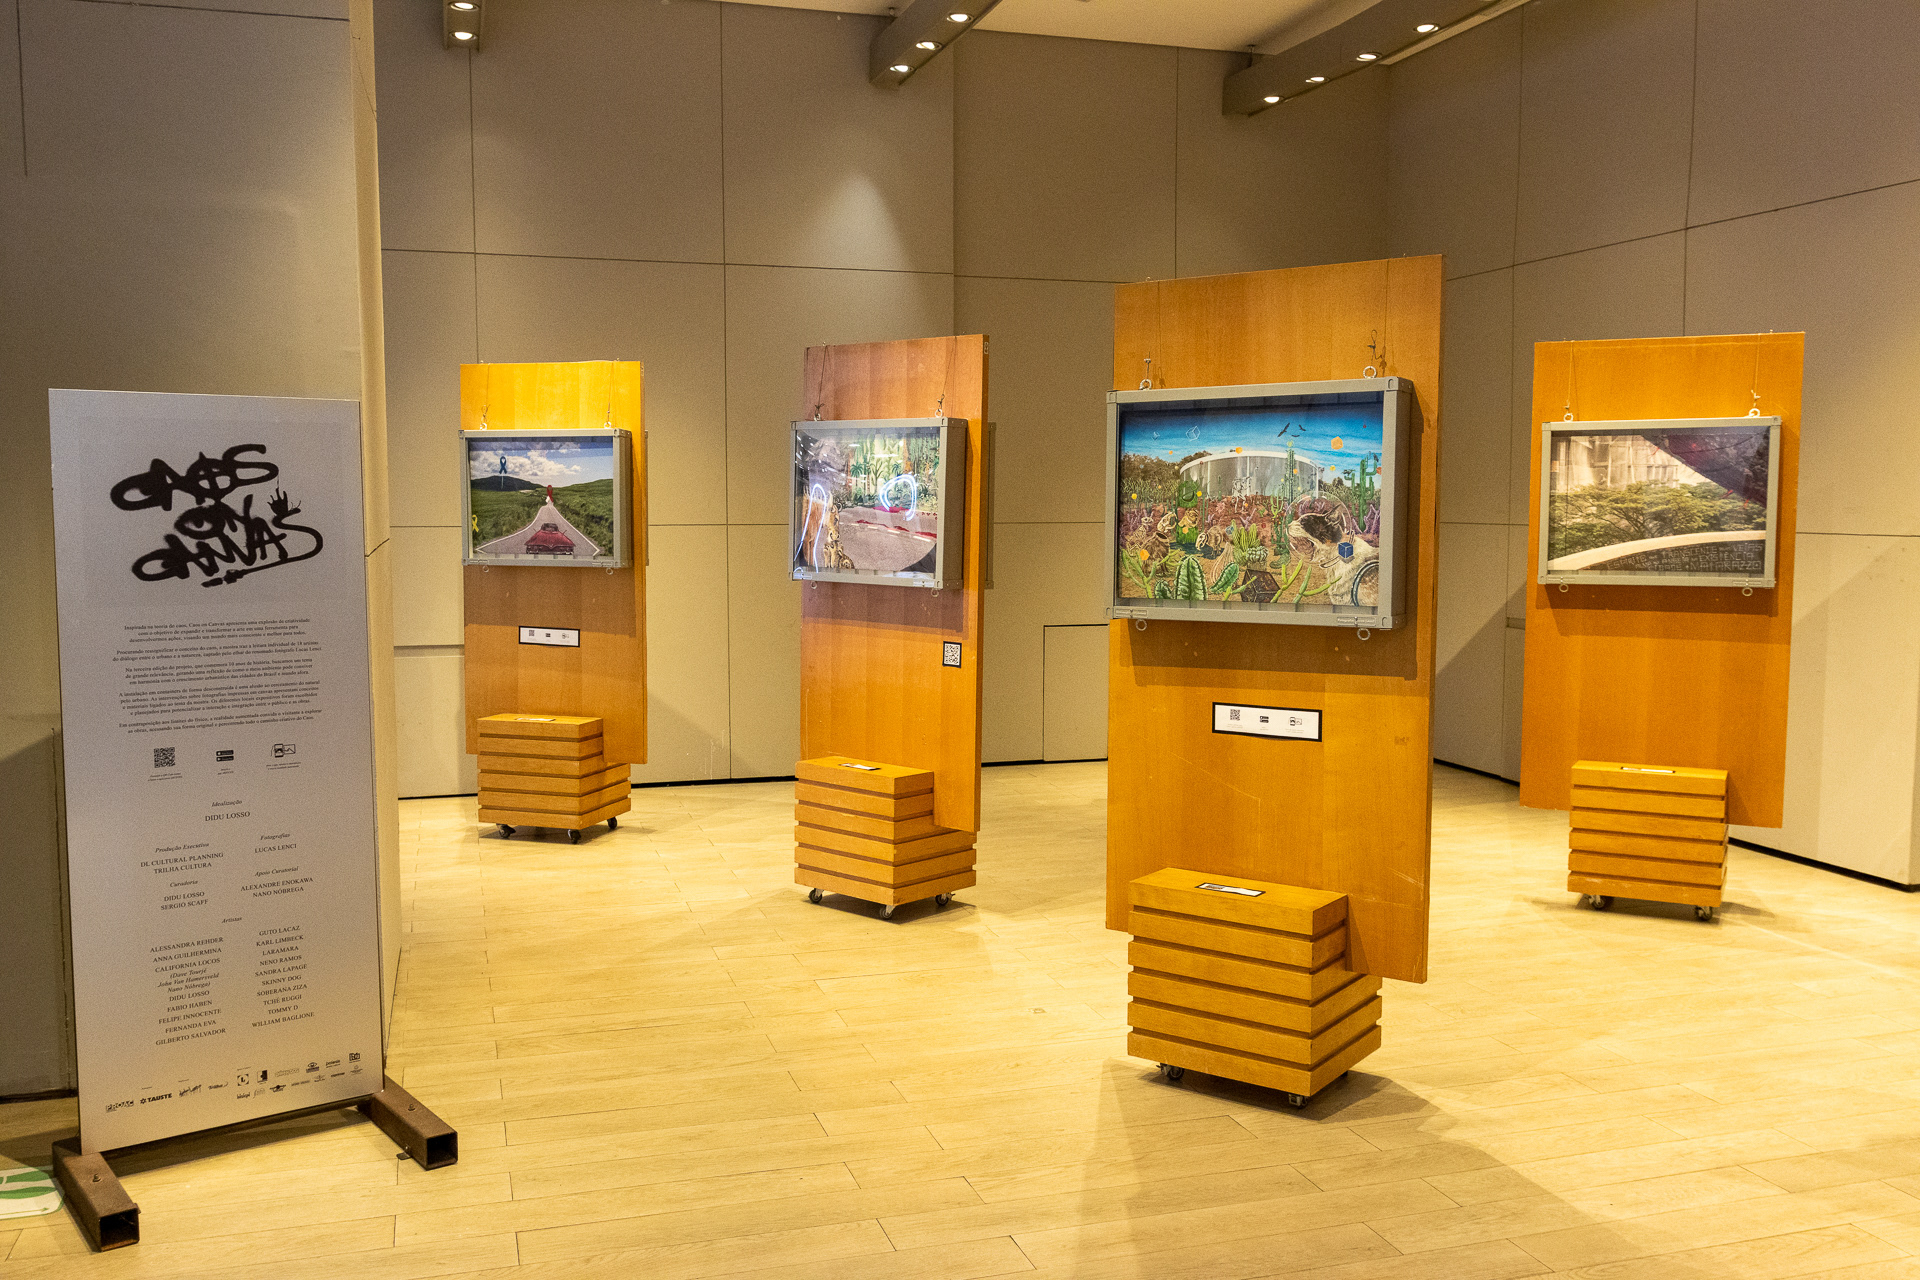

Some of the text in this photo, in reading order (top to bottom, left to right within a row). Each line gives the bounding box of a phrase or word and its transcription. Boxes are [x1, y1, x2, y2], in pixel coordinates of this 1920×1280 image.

[226, 811, 251, 819] LOSSO
[151, 857, 187, 866] CULTURAL
[189, 852, 224, 862] PLANNING
[180, 862, 212, 871] CULTURA
[241, 881, 280, 891] ALEXANDRE
[161, 902, 186, 910] SERGIO
[278, 925, 300, 933] LACAZ
[150, 941, 195, 952] ALESSANDRA
[263, 945, 299, 955] LARAMARA
[174, 948, 222, 960] GUILHERMINA
[279, 954, 302, 963] RAMOS
[155, 958, 221, 973] CALIFORNIA LOCOS
[255, 968, 281, 977] SANDRA
[262, 977, 286, 985] SKINNY
[188, 990, 210, 999] LOSSO
[257, 986, 291, 996] SOBERANA
[168, 1004, 188, 1012] FABIO
[268, 1006, 292, 1014] TOMMY
[159, 1008, 222, 1024] FELIPE INNOCENTE
[252, 1012, 315, 1028] WILLIAM BAGLIONE
[165, 1022, 202, 1033] FERNANDA
[156, 1028, 226, 1045] GILBERTO SALVADOR
[148, 1093, 172, 1102] TAUSTE
